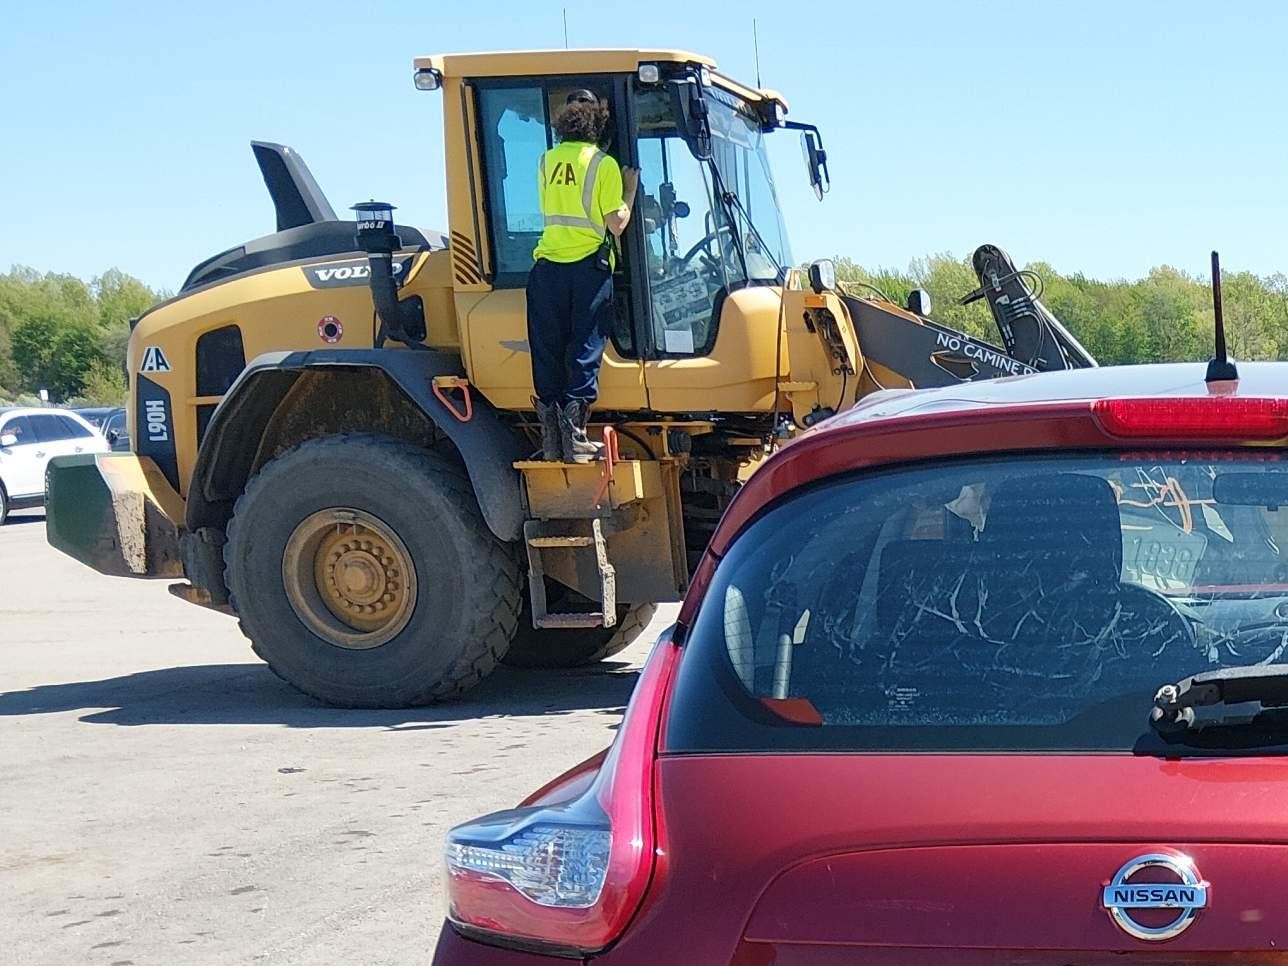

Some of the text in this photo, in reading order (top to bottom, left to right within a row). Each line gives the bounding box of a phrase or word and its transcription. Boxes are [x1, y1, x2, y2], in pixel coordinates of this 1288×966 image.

[357, 221, 375, 230] urbo
[314, 262, 403, 281] VOLO
[936, 333, 960, 351] NO
[964, 345, 1019, 376] CAMINE
[145, 400, 168, 441] L90H
[1114, 889, 1195, 903] NISSAN
